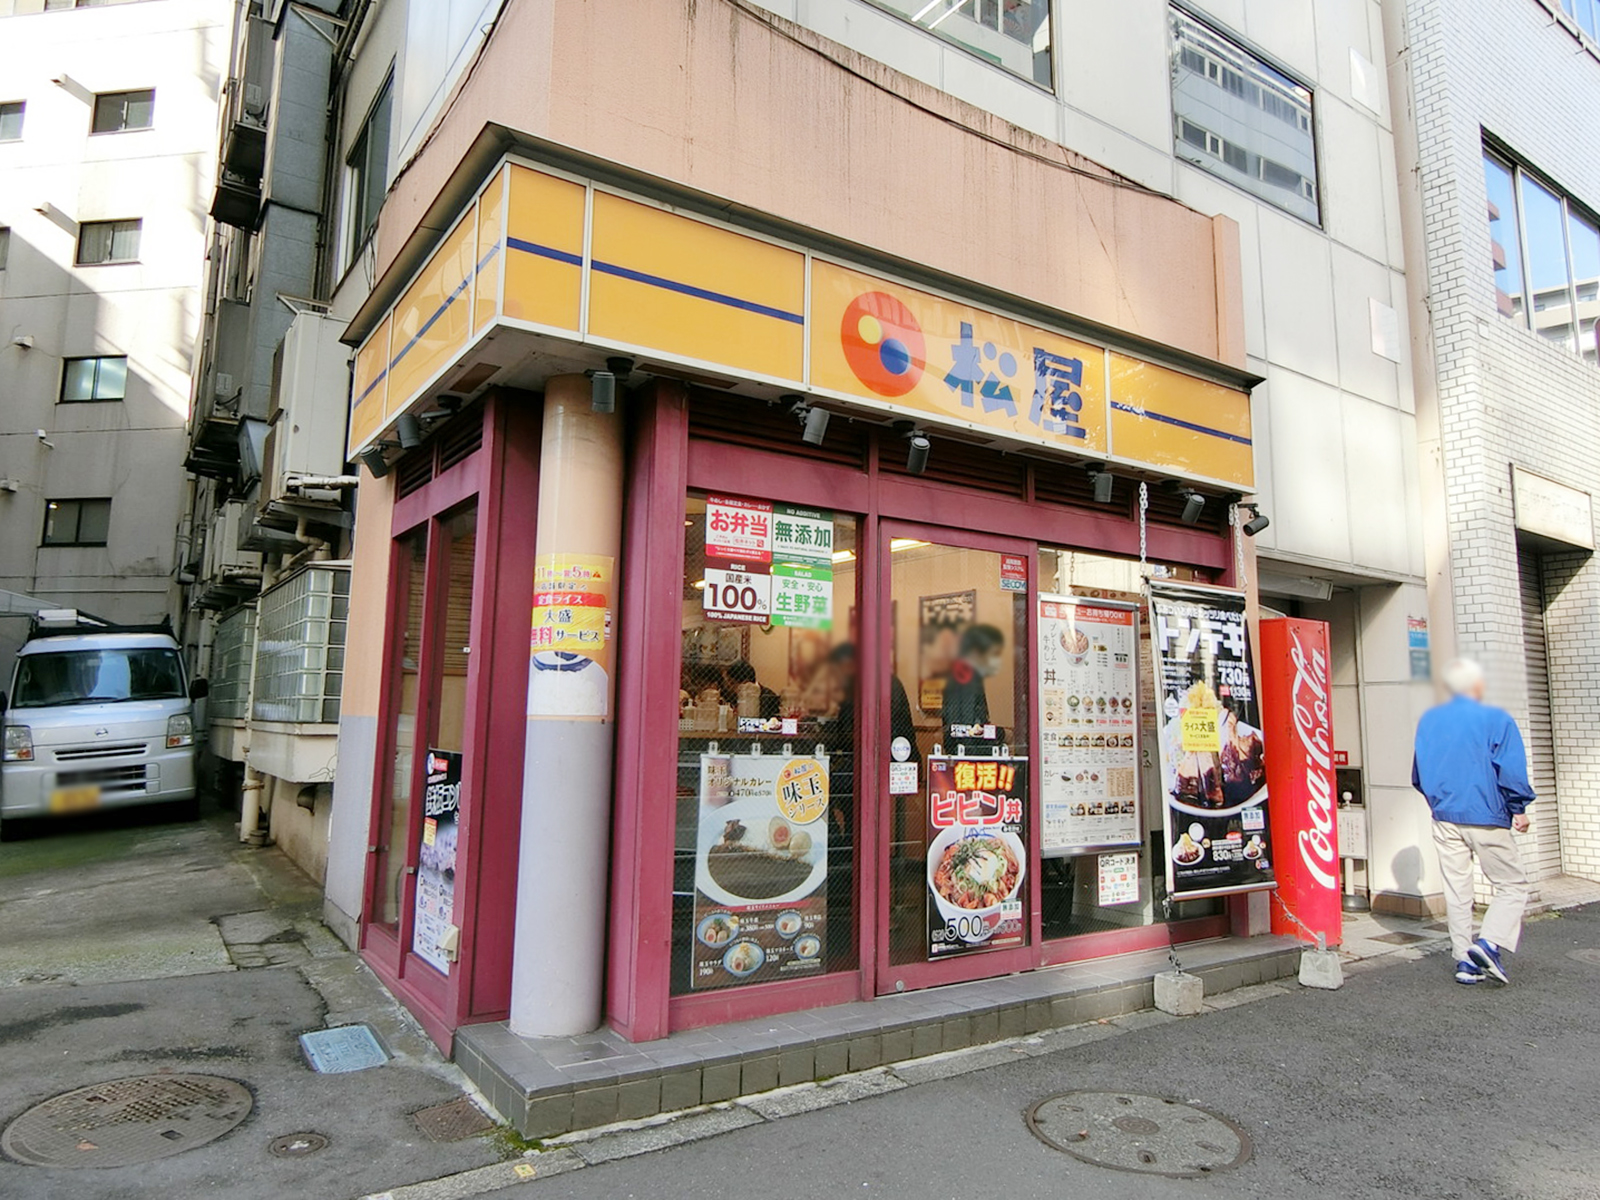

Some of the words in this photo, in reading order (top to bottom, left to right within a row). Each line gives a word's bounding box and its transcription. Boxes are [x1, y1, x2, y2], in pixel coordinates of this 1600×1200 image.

[943, 321, 1086, 438] 松屋
[710, 509, 767, 538] お弁当
[775, 521, 831, 548] 無添加
[725, 573, 752, 585] 国産米
[794, 570, 812, 578] SALAD
[782, 579, 823, 592] 安全・安心
[538, 594, 583, 605] 定食ライス
[708, 583, 767, 610] 100%
[776, 592, 828, 614] 生野菜
[544, 609, 572, 623] 大盛
[723, 613, 752, 622] JAPANESE
[753, 615, 767, 623] RICE
[1158, 615, 1245, 657] トンテキ
[1043, 668, 1056, 685] 丼
[1184, 720, 1216, 732] ライス大盛
[1291, 627, 1336, 890] Coca-Cola
[708, 778, 772, 787] オリジナルカレー
[954, 762, 1015, 791] 復活!!
[782, 773, 823, 803] 味玉
[788, 797, 825, 818] シリーズ
[931, 791, 1022, 828] ビビン丼
